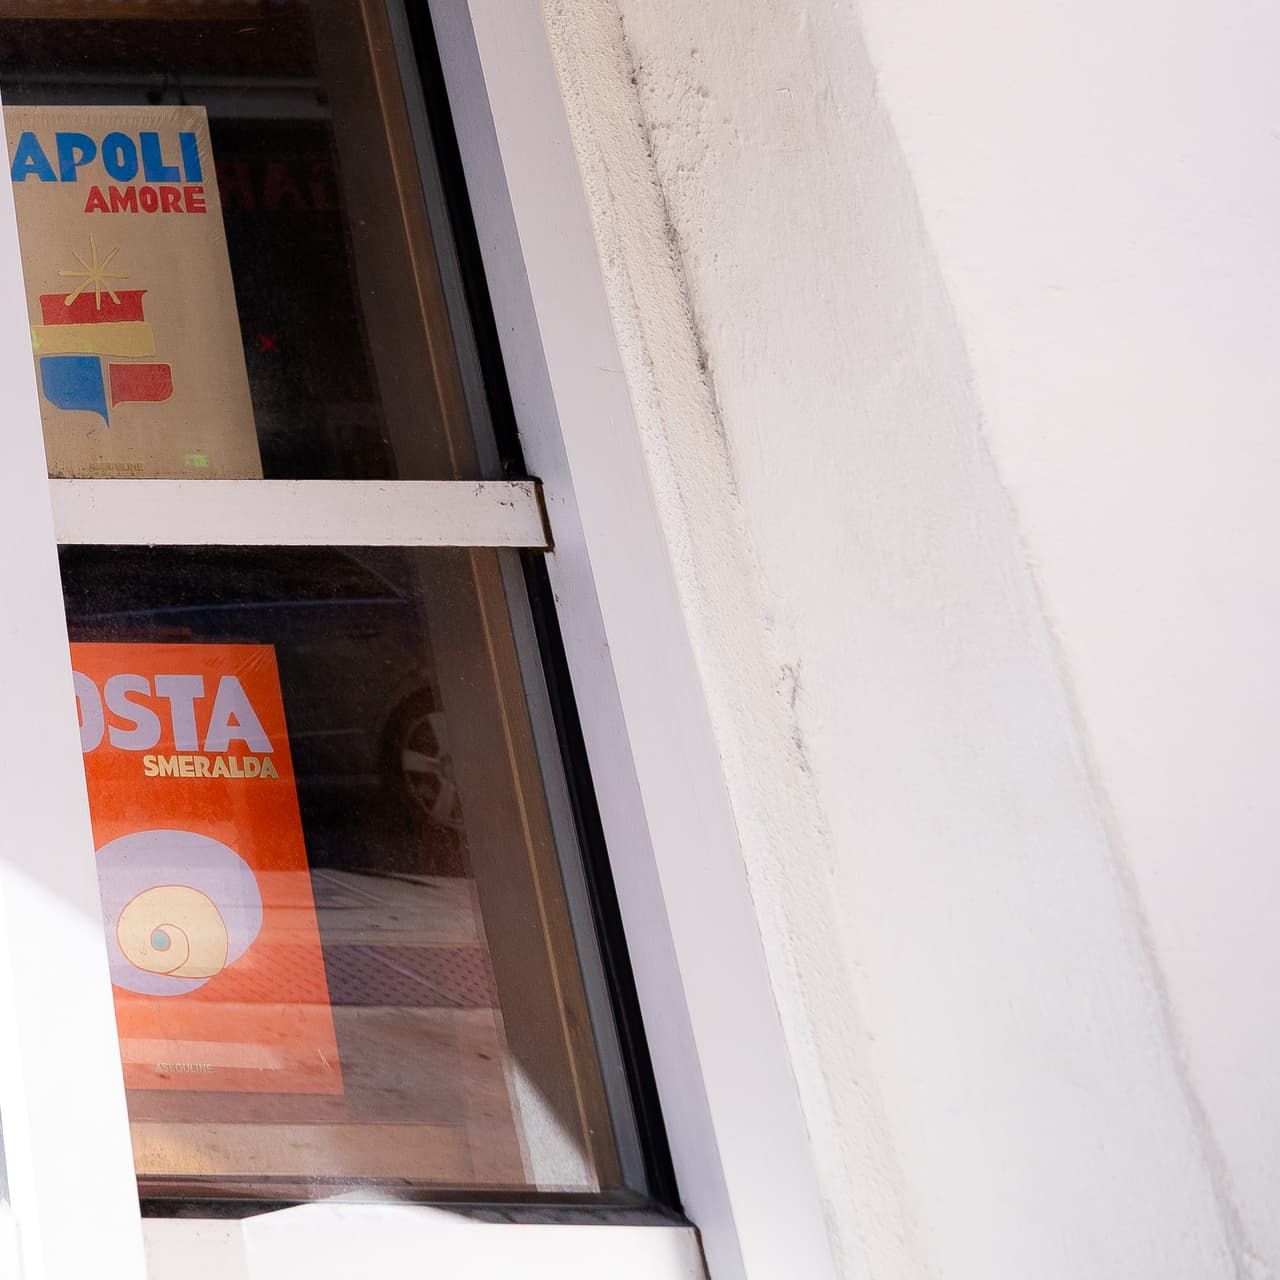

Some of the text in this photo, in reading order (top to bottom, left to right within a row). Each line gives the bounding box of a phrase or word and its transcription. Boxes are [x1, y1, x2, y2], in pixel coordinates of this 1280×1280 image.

[11, 131, 203, 183] APOLI
[84, 185, 207, 214] AMORE
[143, 754, 279, 779] SMERALDA
